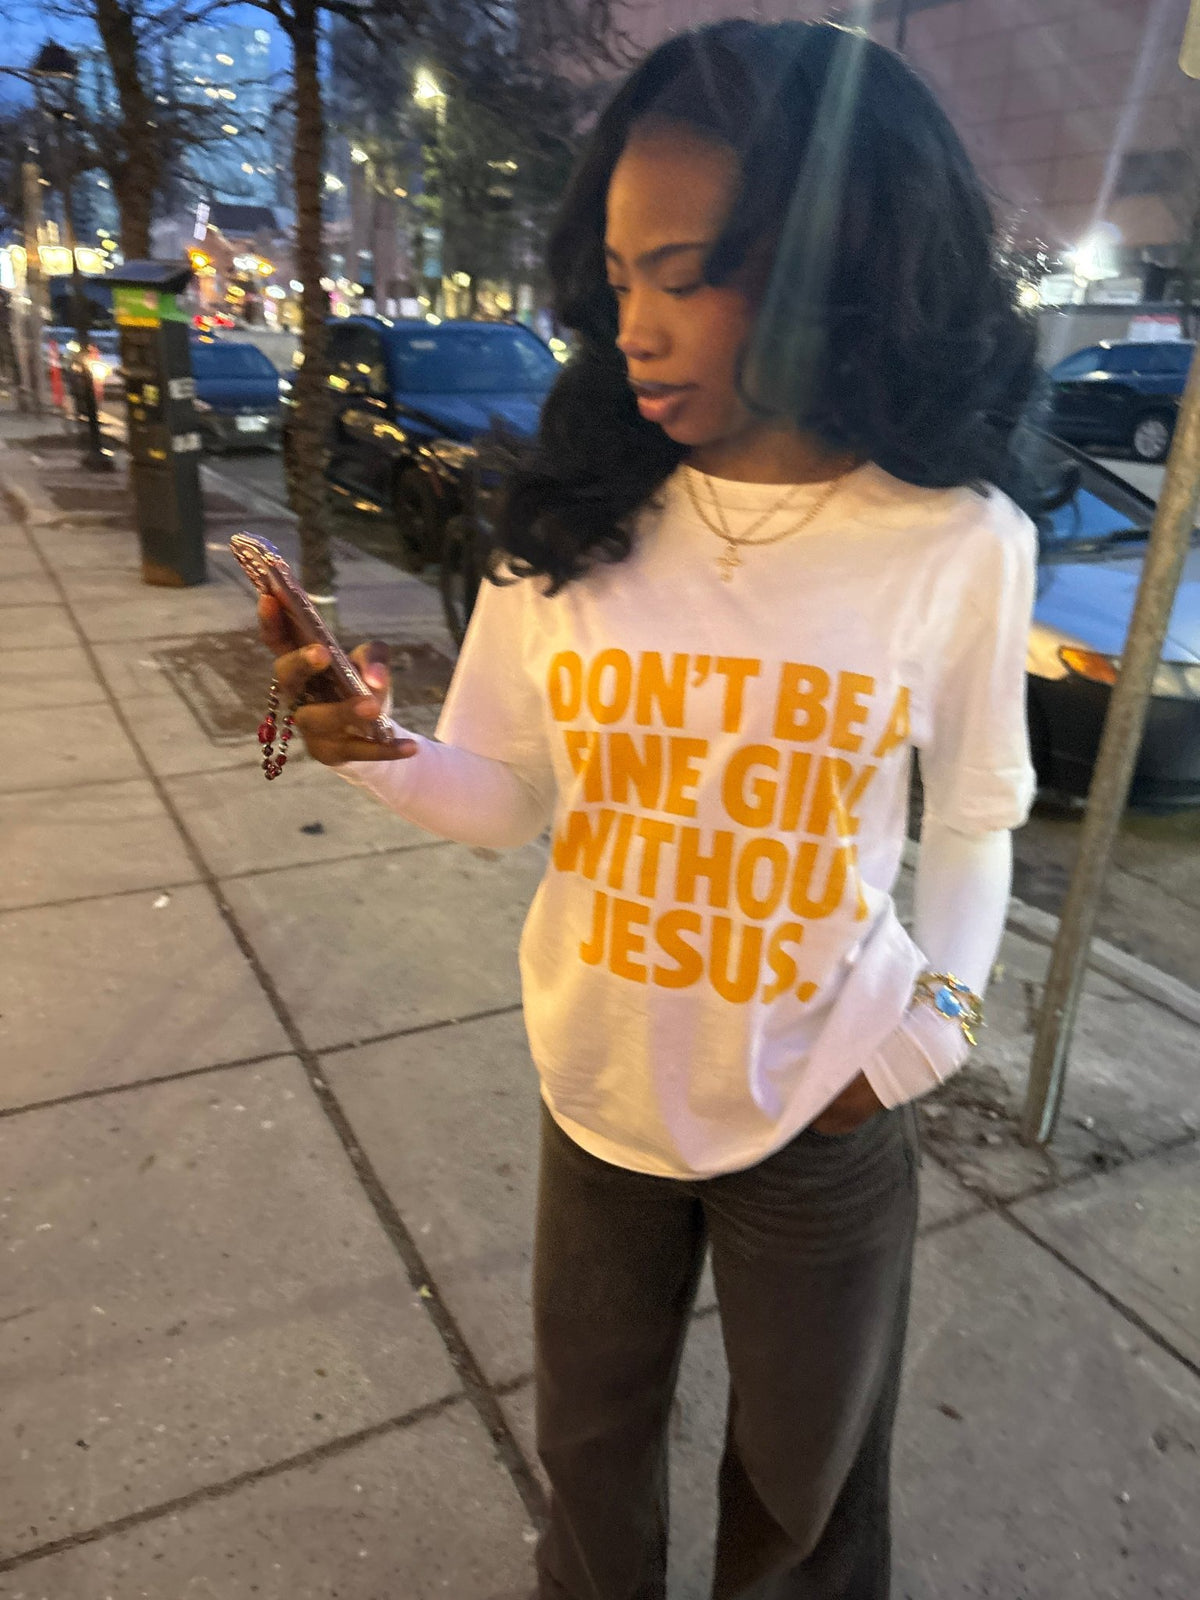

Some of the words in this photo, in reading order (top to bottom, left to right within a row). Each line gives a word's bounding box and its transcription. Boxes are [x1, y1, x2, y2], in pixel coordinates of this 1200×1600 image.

[547, 648, 761, 734] DON'T
[773, 661, 876, 753] BE
[552, 807, 868, 921] WITHOU
[578, 889, 819, 1004] JESUS.
